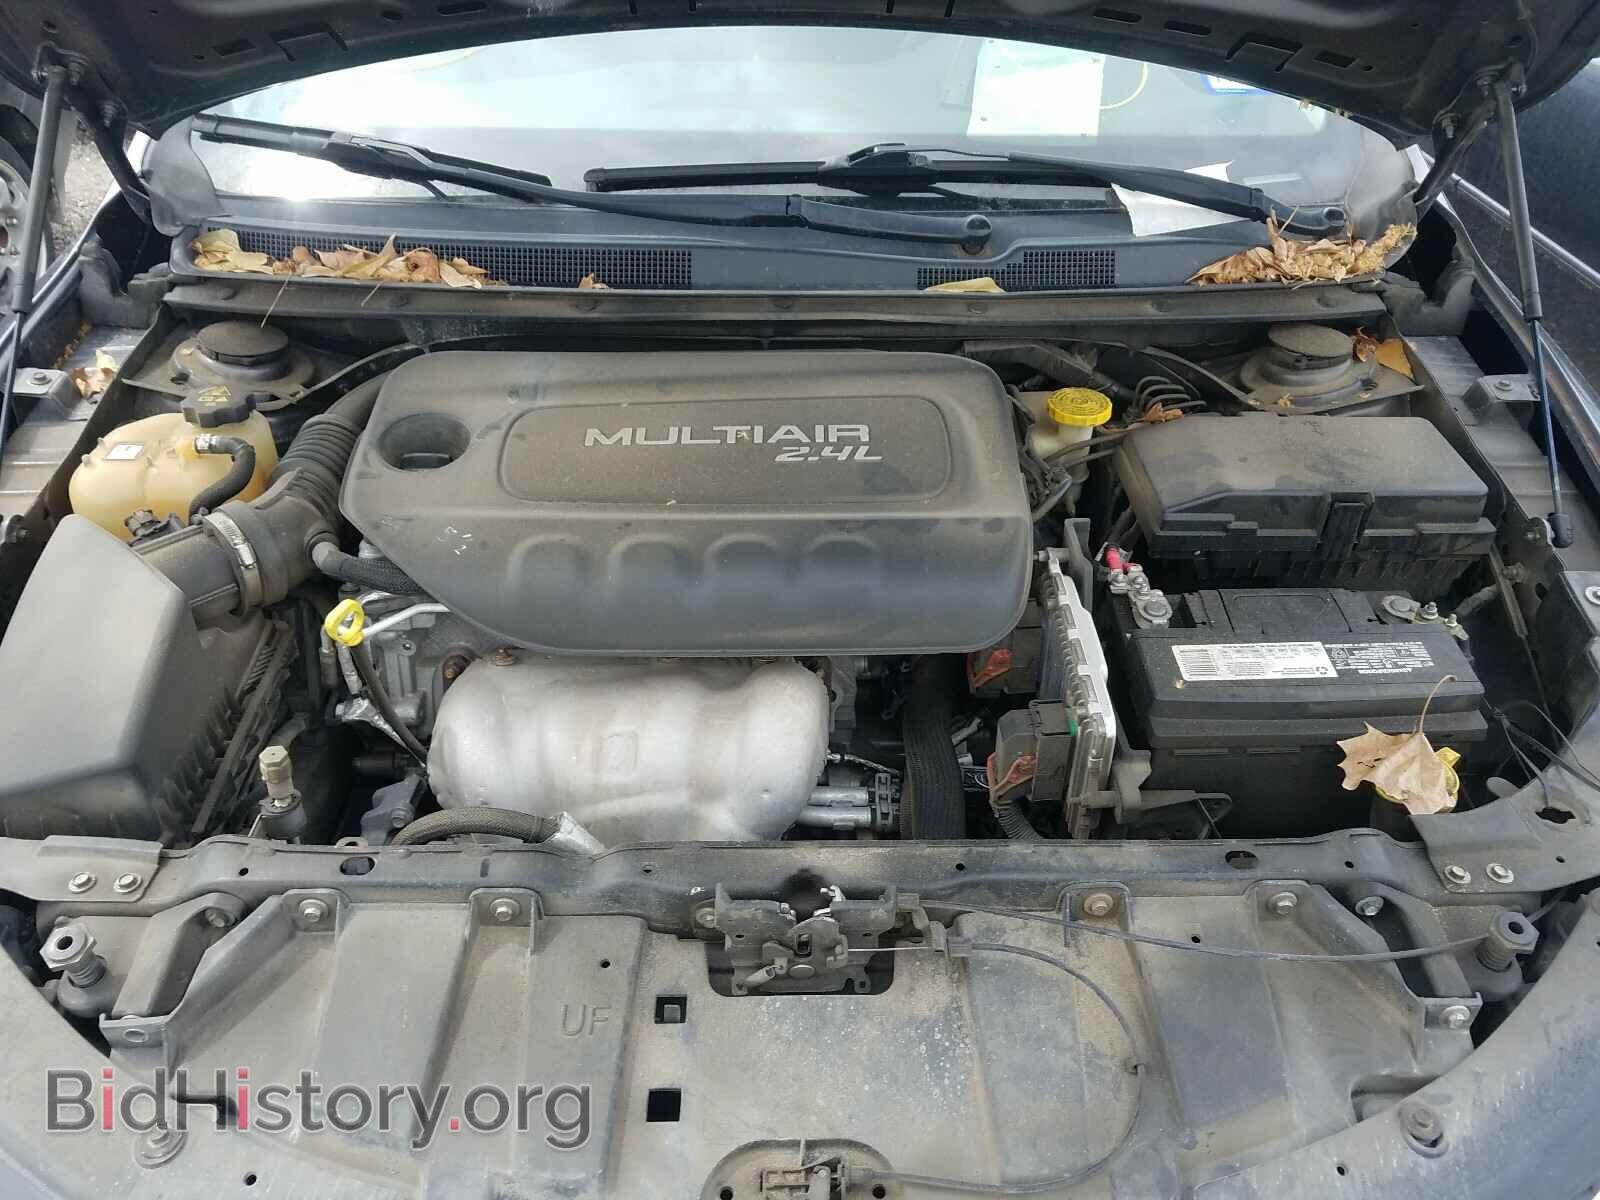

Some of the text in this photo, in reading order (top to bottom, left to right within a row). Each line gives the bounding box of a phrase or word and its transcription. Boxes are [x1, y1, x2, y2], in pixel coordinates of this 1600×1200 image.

[584, 424, 870, 447] MULTIAIR
[775, 445, 883, 462] 2.4L
[560, 1003, 612, 1038] UF
